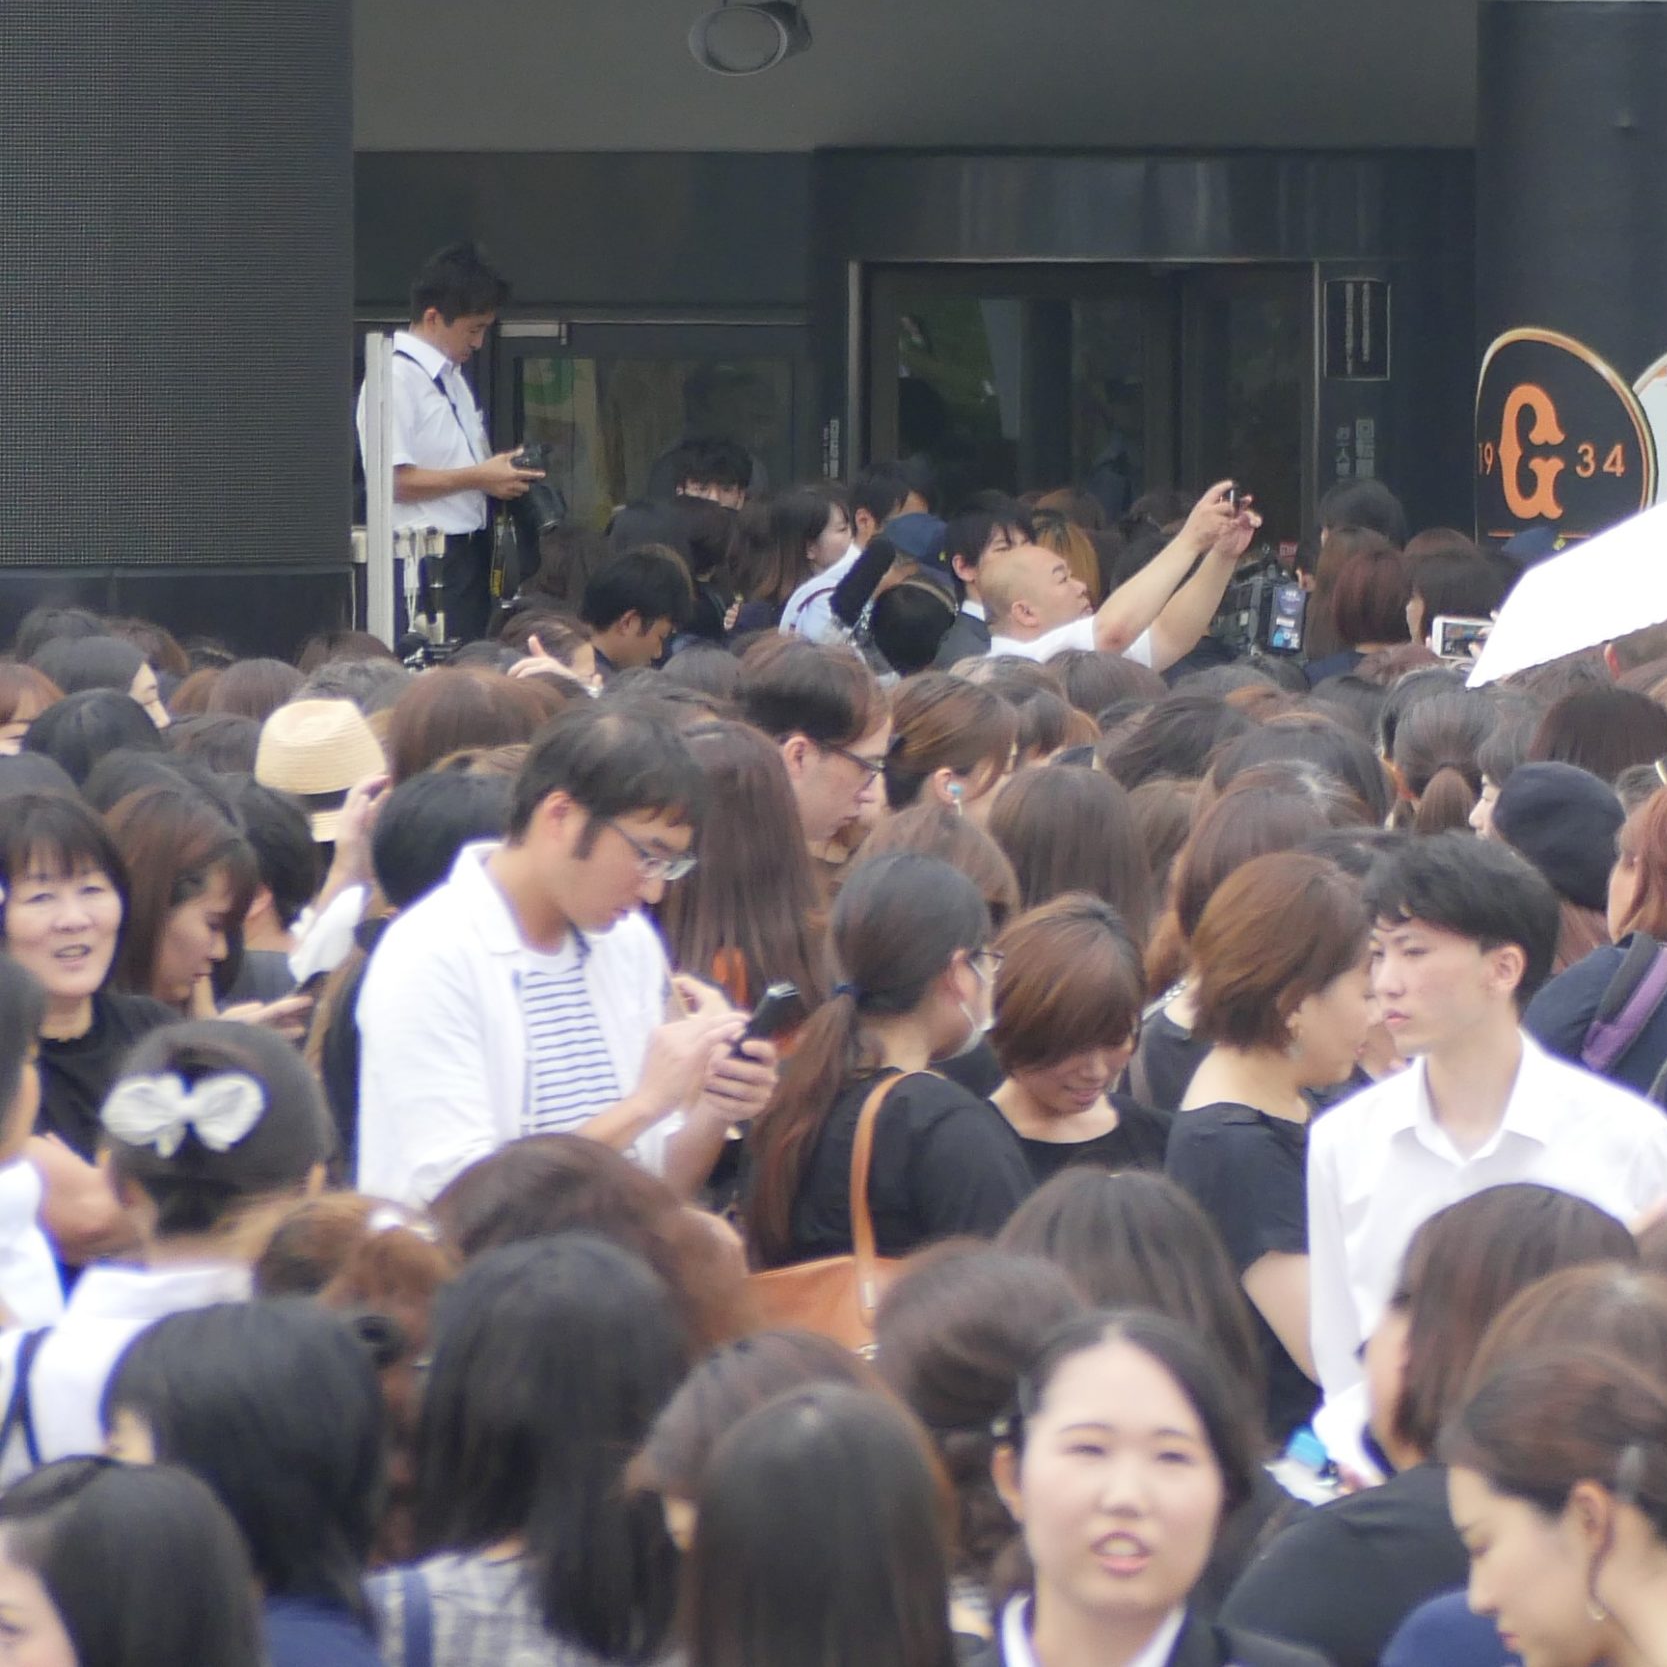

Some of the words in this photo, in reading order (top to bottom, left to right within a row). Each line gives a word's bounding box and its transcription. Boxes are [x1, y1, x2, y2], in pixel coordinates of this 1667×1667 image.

[1478, 441, 1495, 476] 19
[1498, 383, 1567, 520] G
[1575, 442, 1626, 478] 34
